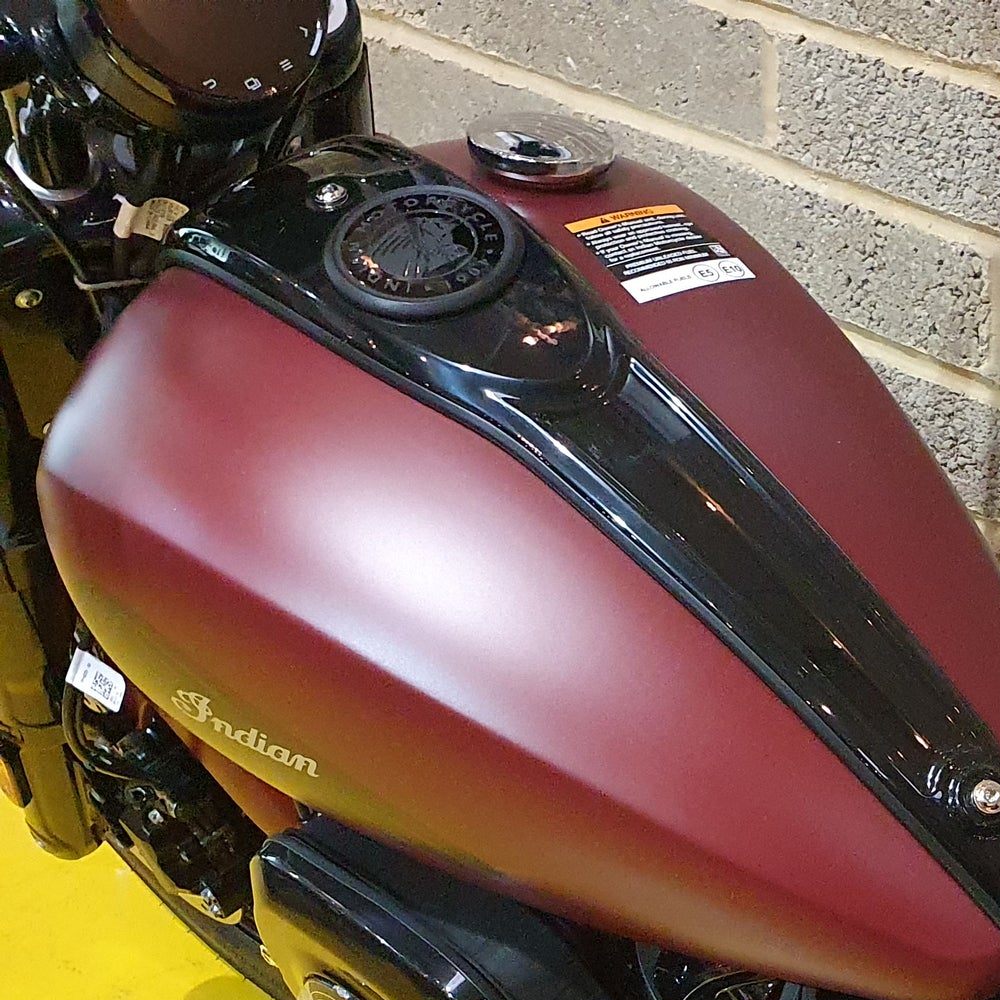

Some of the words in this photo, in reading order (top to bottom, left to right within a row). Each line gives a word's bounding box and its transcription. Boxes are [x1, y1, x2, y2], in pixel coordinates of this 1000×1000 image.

[697, 269, 714, 278] E5
[723, 263, 743, 274] E10
[171, 689, 320, 778] Indian
